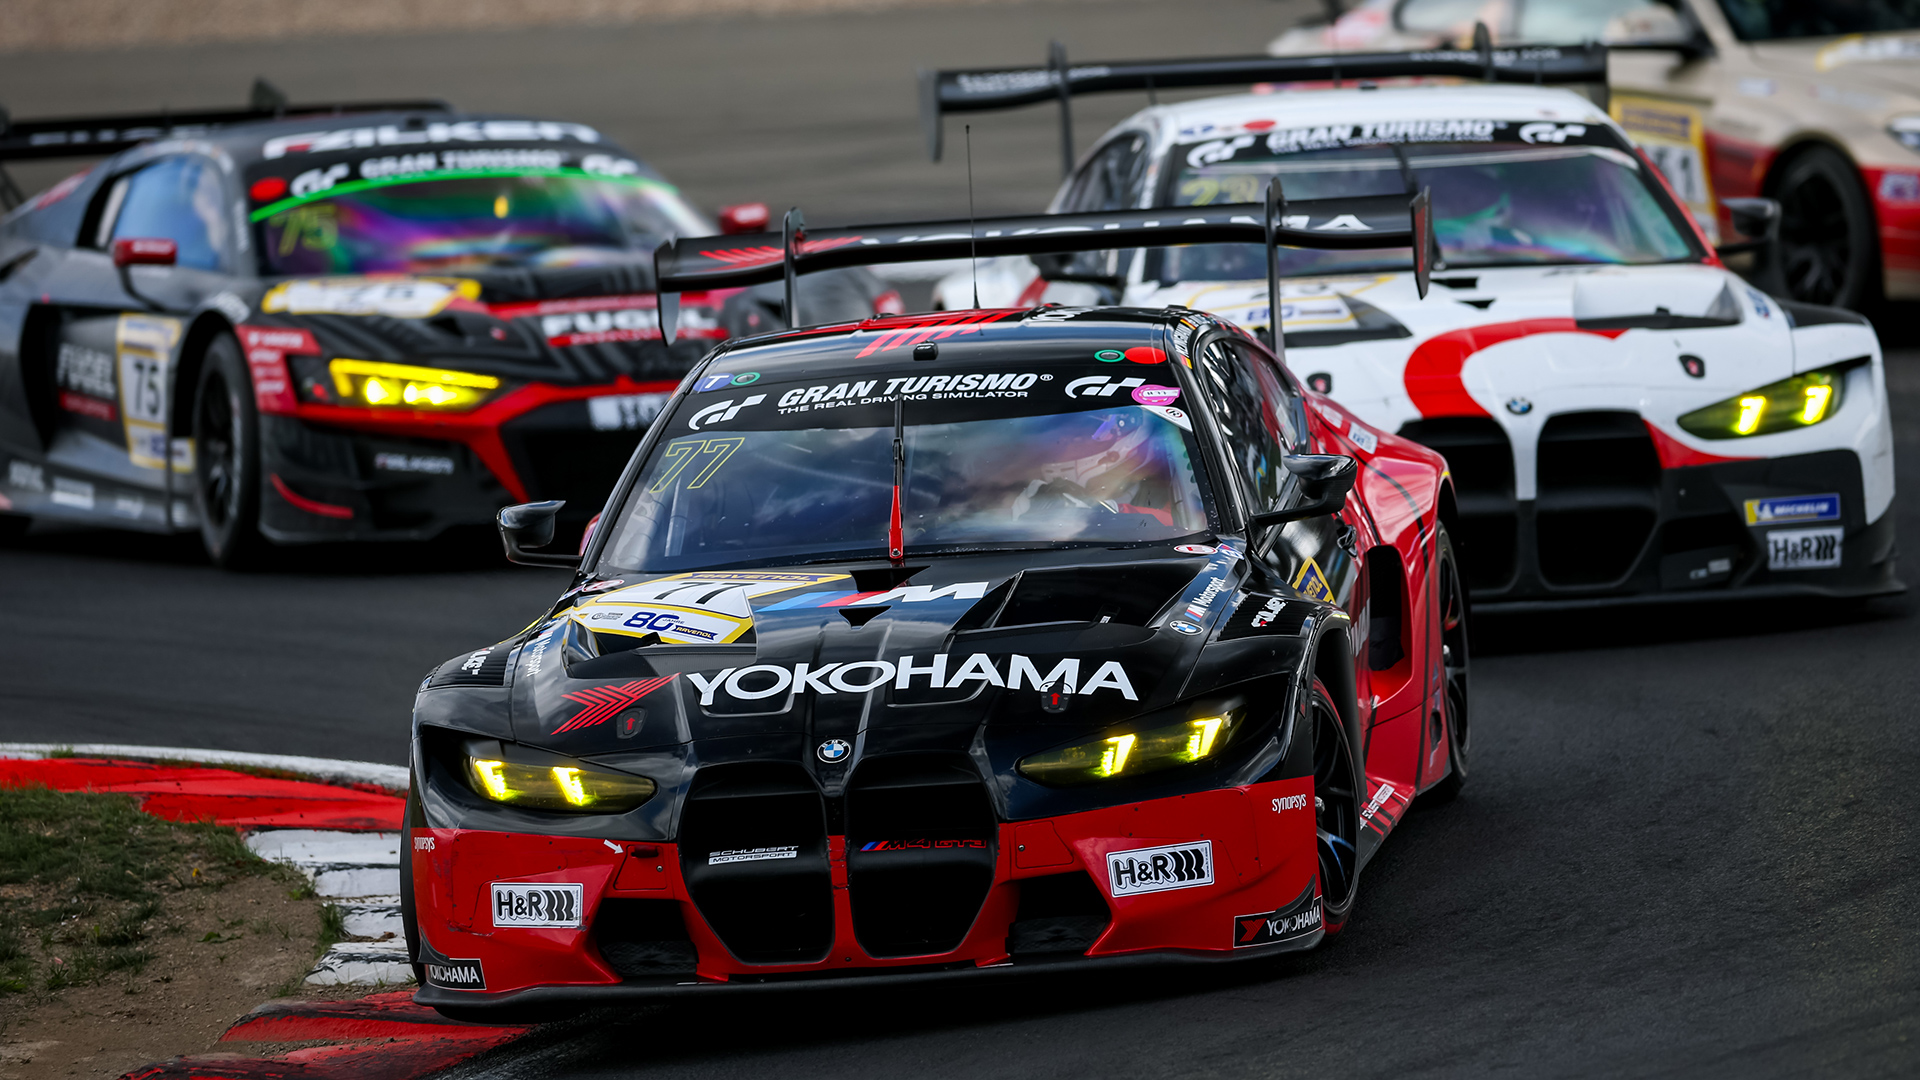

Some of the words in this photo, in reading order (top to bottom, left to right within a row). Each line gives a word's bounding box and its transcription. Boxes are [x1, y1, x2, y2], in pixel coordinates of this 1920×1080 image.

[1266, 126, 1350, 149] GRAN
[360, 152, 438, 178] GRAN
[541, 309, 718, 337] FUGL
[134, 360, 160, 417] 75
[777, 380, 878, 408] GRAN
[778, 404, 809, 414] THE
[814, 400, 856, 411] REAL
[932, 391, 1028, 400] SIMULATOR
[649, 437, 745, 493] 77
[694, 573, 811, 581] RAVENOL
[653, 582, 756, 605] 77
[1191, 576, 1226, 608] Motorsport
[676, 626, 712, 639] RAVENOL
[686, 652, 1139, 706] YOKOHAMA
[709, 845, 799, 857] SCHUBERT
[711, 851, 793, 864] MOTORSPORT
[934, 839, 987, 849] GT3
[1114, 854, 1174, 888] H&R
[496, 890, 546, 919] H&R
[1266, 905, 1321, 937] YOKOHAMA
